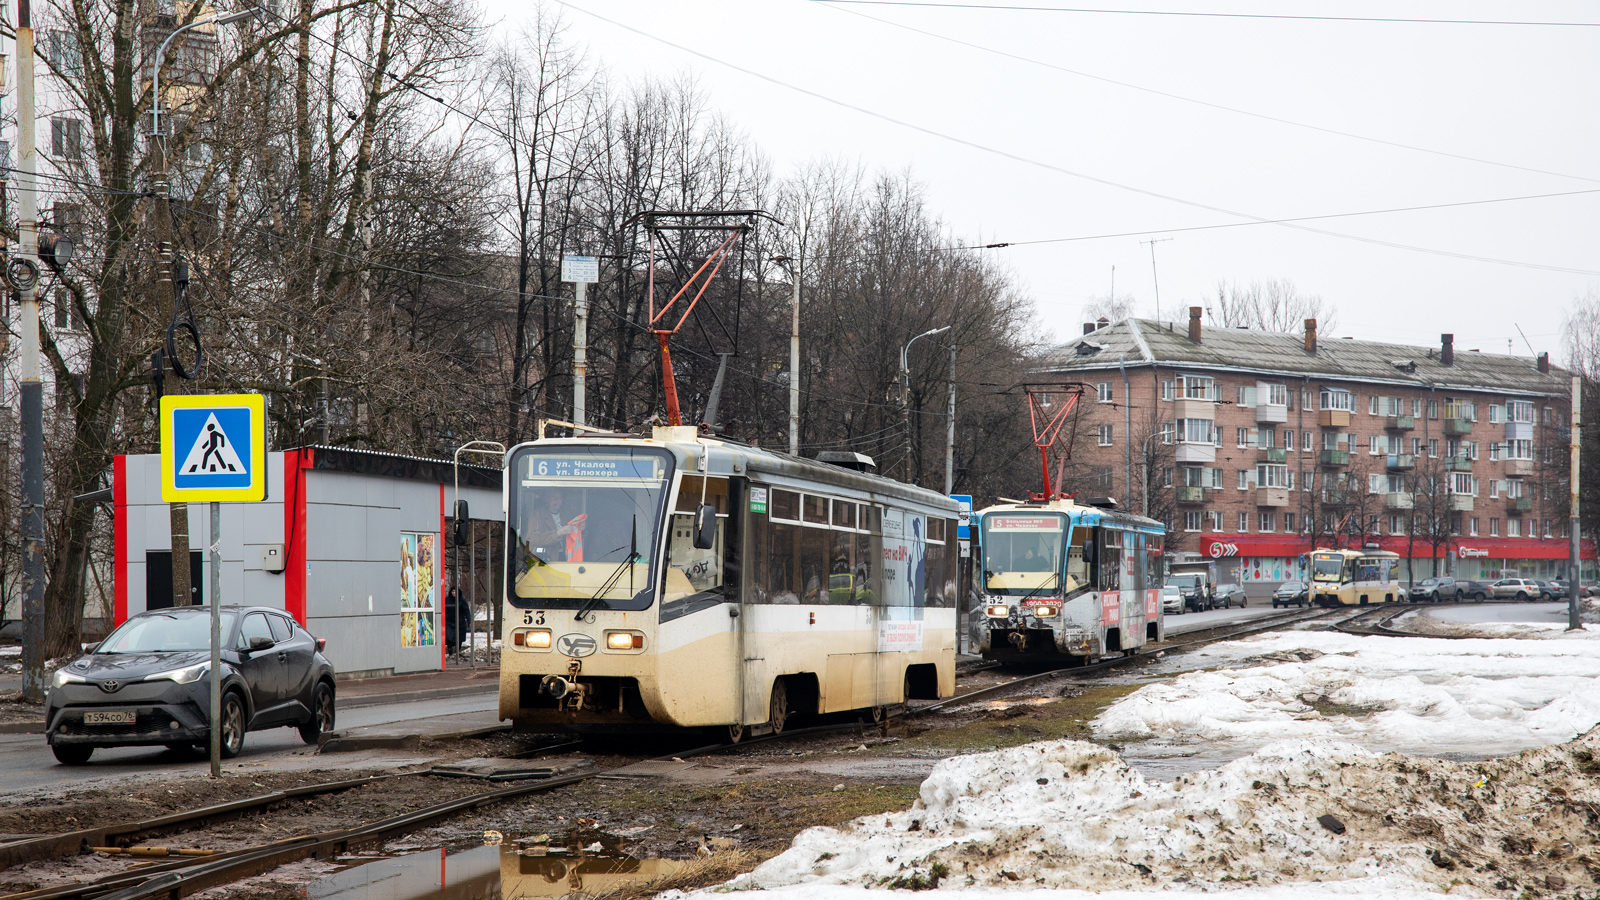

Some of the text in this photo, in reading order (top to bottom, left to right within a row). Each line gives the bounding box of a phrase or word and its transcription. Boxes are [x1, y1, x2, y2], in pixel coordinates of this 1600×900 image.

[538, 460, 548, 476] 6
[556, 460, 616, 469] ул. Чкалова
[574, 469, 618, 477] Блюхера
[996, 519, 1002, 528] 5
[989, 595, 1004, 604] 52
[523, 610, 546, 625] 53
